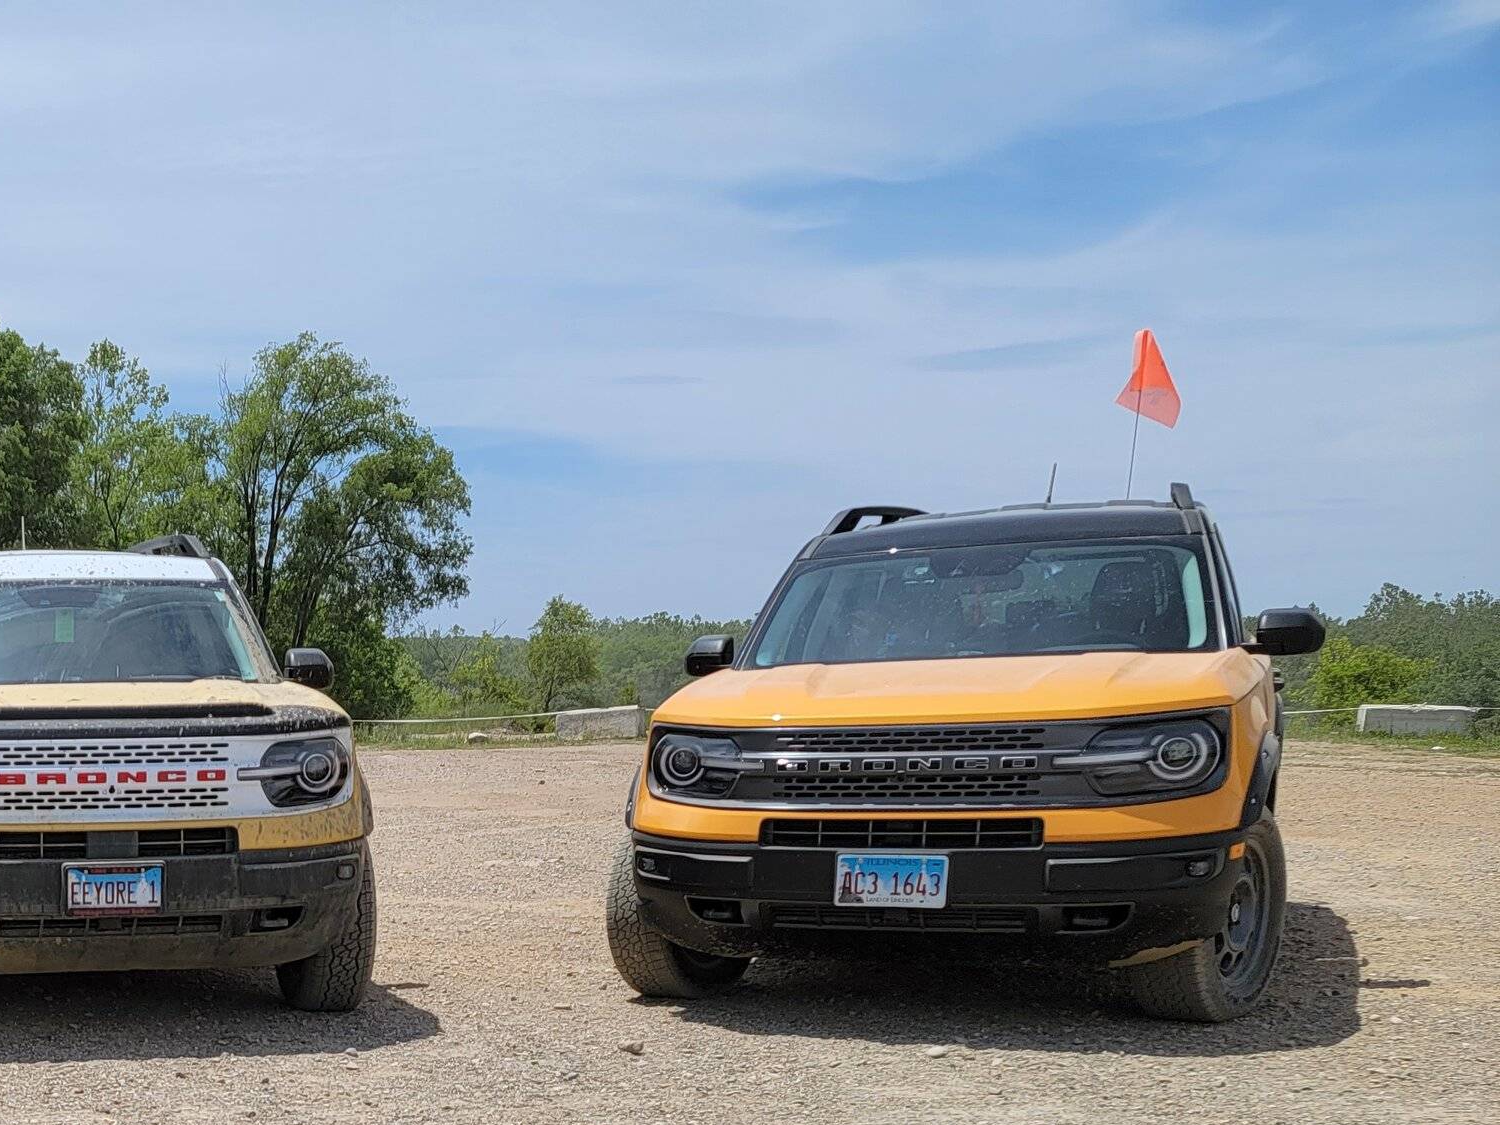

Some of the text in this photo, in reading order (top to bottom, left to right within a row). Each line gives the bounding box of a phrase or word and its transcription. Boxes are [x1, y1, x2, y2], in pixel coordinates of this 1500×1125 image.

[776, 756, 1038, 772] BRONCO
[71, 880, 158, 905] EEYORE 1
[842, 871, 940, 897] AC3 1643
